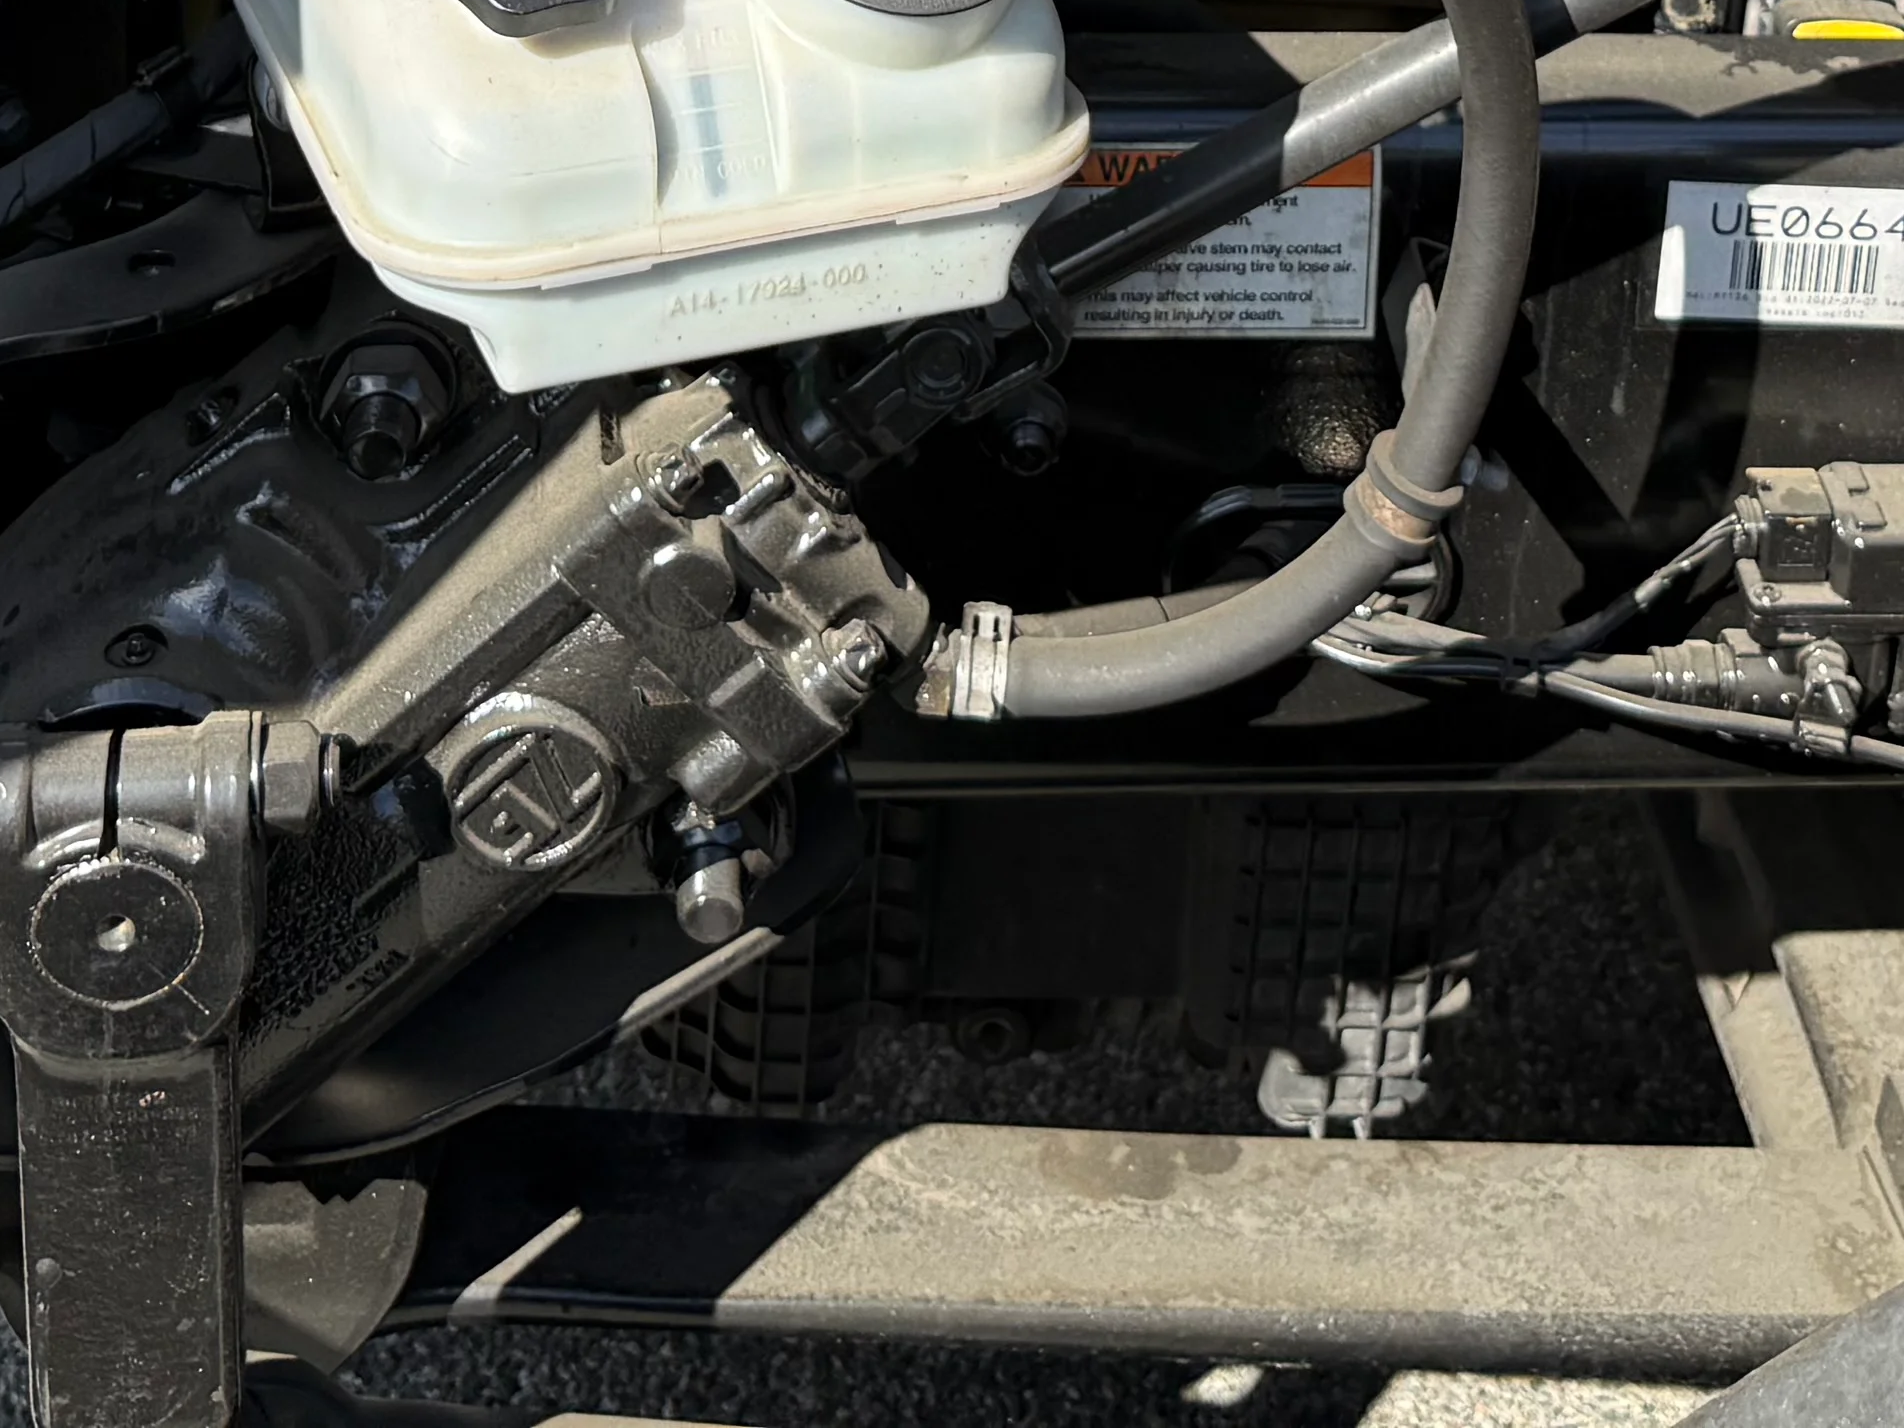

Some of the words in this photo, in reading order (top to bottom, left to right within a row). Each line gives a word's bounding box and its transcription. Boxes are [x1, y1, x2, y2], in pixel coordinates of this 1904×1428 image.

[1211, 243, 1248, 255] stem
[1251, 244, 1283, 257] may
[1287, 243, 1342, 255] contact
[1187, 262, 1246, 275] causing
[1251, 261, 1276, 272] tire
[1279, 261, 1294, 272] to
[1298, 261, 1330, 272] lose
[1333, 261, 1356, 272] air.
[1121, 291, 1153, 305] may
[1156, 289, 1199, 302] affect
[1203, 289, 1256, 302] vehicle
[1260, 289, 1314, 302] control
[1085, 309, 1151, 324] resulting
[1154, 309, 1169, 322] in
[1172, 309, 1215, 324] injury
[1219, 311, 1234, 322] or
[1239, 309, 1284, 322] death.
